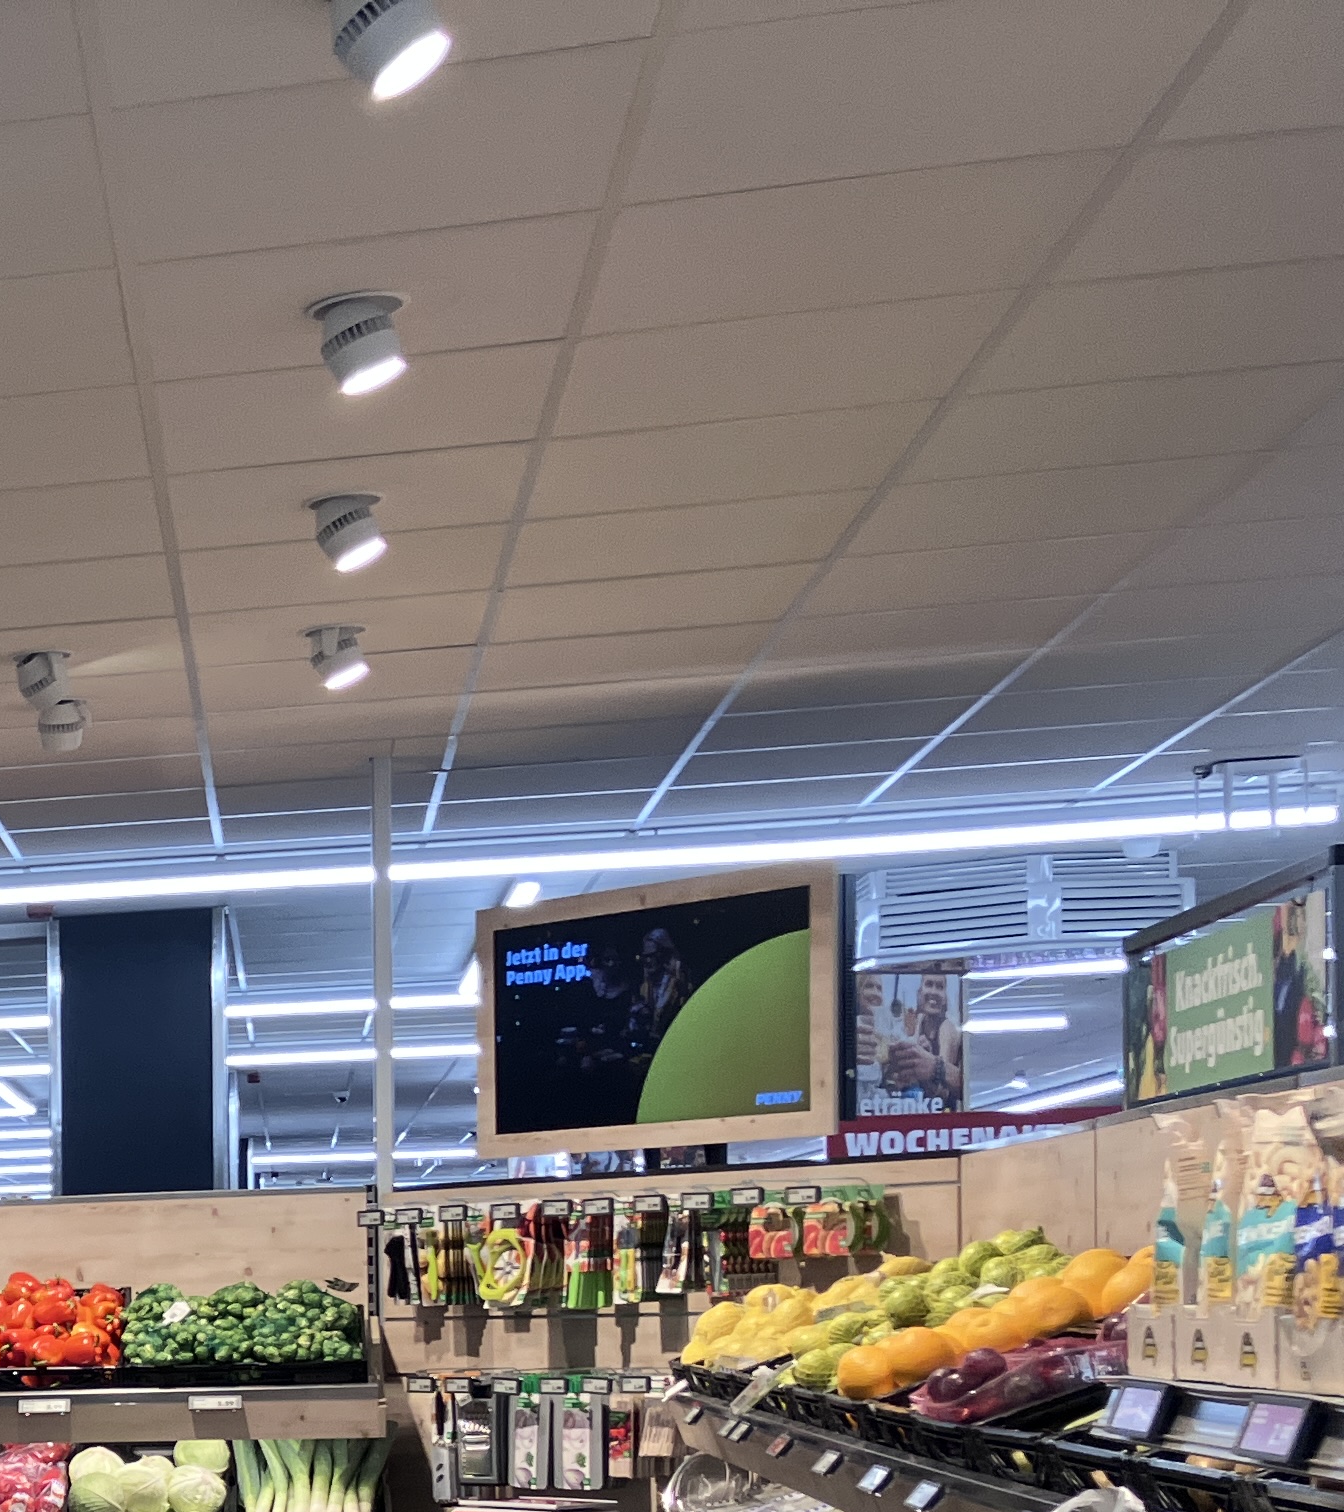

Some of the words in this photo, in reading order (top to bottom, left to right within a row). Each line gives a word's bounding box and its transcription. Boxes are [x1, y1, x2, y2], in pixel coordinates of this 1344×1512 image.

[506, 947, 542, 967] Jetzt
[543, 943, 559, 962] in
[561, 941, 588, 959] der
[506, 968, 553, 986] Penny
[554, 964, 592, 983] App.
[1175, 942, 1263, 1012] Knackfrisch.
[755, 1090, 803, 1106] PENNY
[858, 1090, 951, 1117] etränke.
